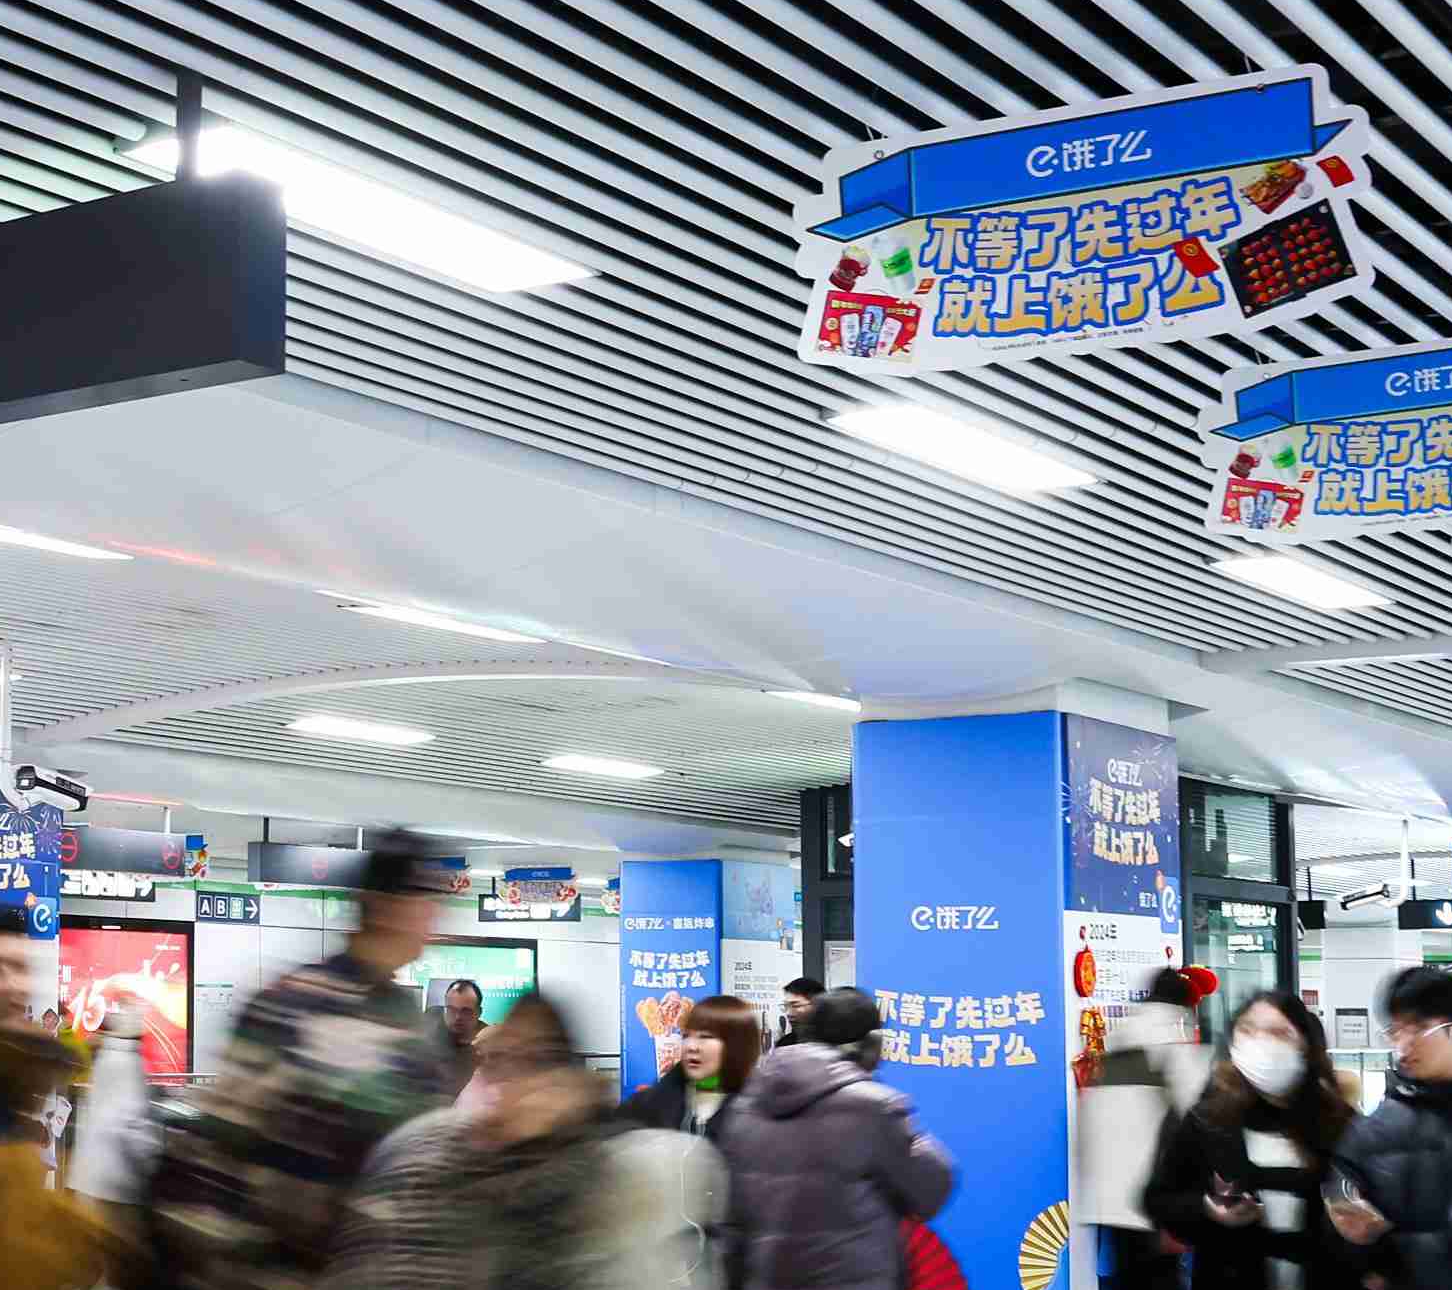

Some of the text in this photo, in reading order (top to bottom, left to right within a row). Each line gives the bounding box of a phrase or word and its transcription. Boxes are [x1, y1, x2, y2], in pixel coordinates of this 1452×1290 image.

[919, 177, 1242, 275] 不等了先过年
[933, 249, 1227, 337] 就上饿了么
[201, 899, 210, 914] A
[217, 900, 226, 915] B
[873, 990, 1045, 1030] 不等了先过年
[874, 1028, 1038, 1069] 就上饿了么
